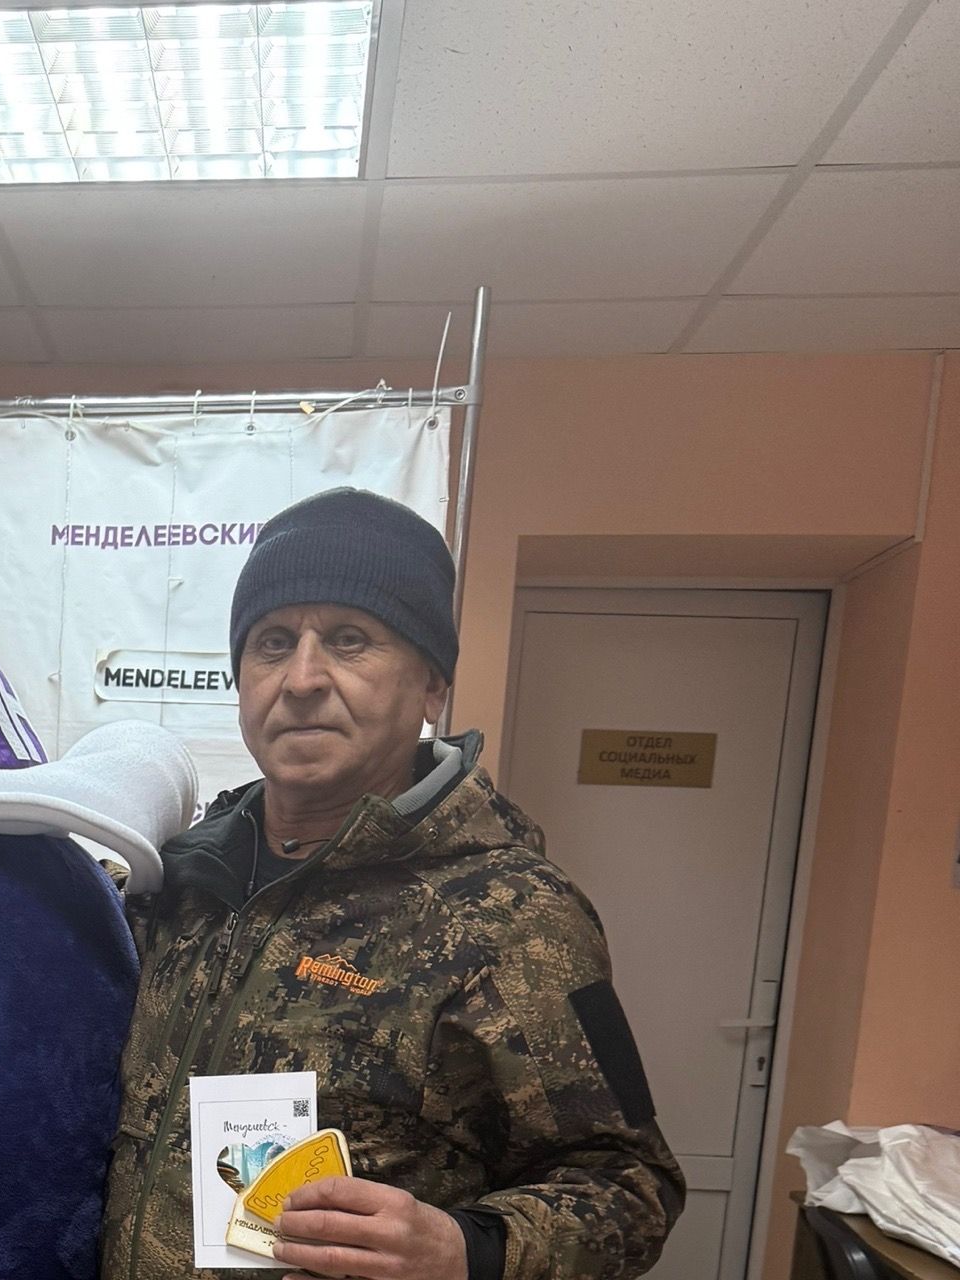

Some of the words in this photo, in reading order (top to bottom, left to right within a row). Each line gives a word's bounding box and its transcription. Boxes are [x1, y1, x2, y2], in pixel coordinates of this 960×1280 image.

[104, 666, 234, 690] MENDELEEV
[626, 735, 673, 750] ОТДЕЛ
[598, 750, 698, 766] СОЦИАЛЬНЫХ
[620, 767, 672, 781] МЕДИА
